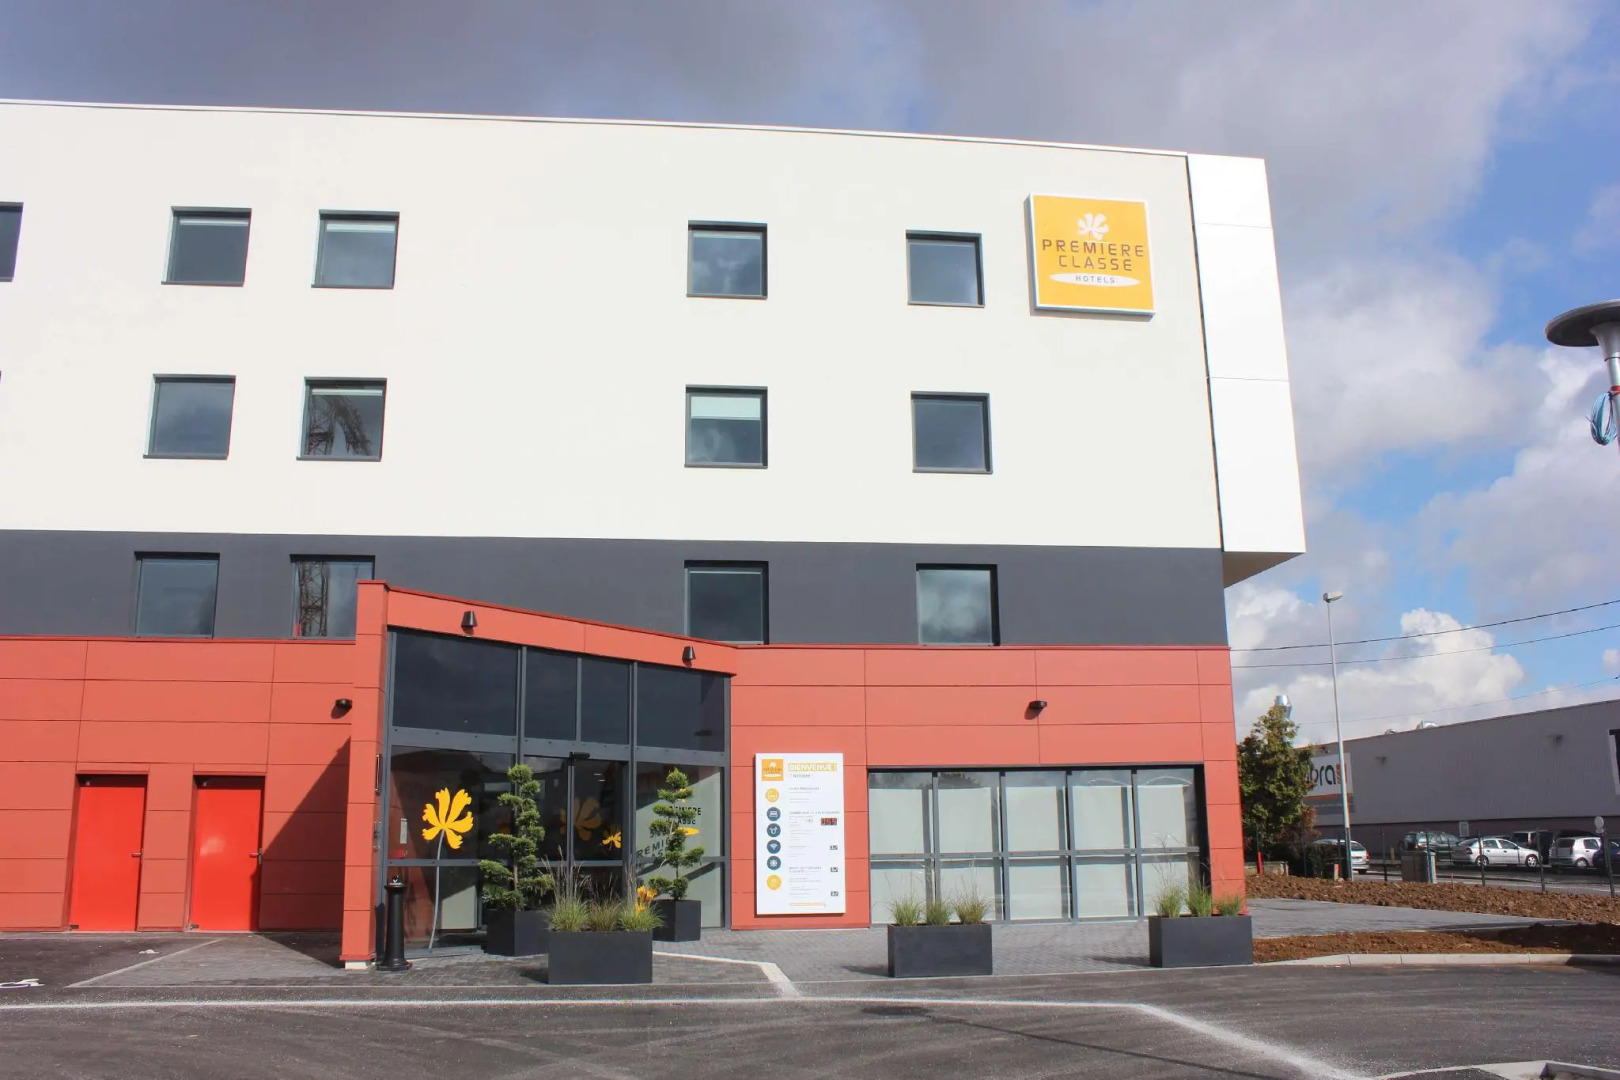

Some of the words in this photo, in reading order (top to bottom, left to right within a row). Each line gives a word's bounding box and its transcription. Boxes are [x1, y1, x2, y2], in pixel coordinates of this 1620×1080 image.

[1042, 239, 1143, 257] PREMIERE
[1059, 255, 1132, 271] CLASSE
[1075, 275, 1116, 284] HOTELS
